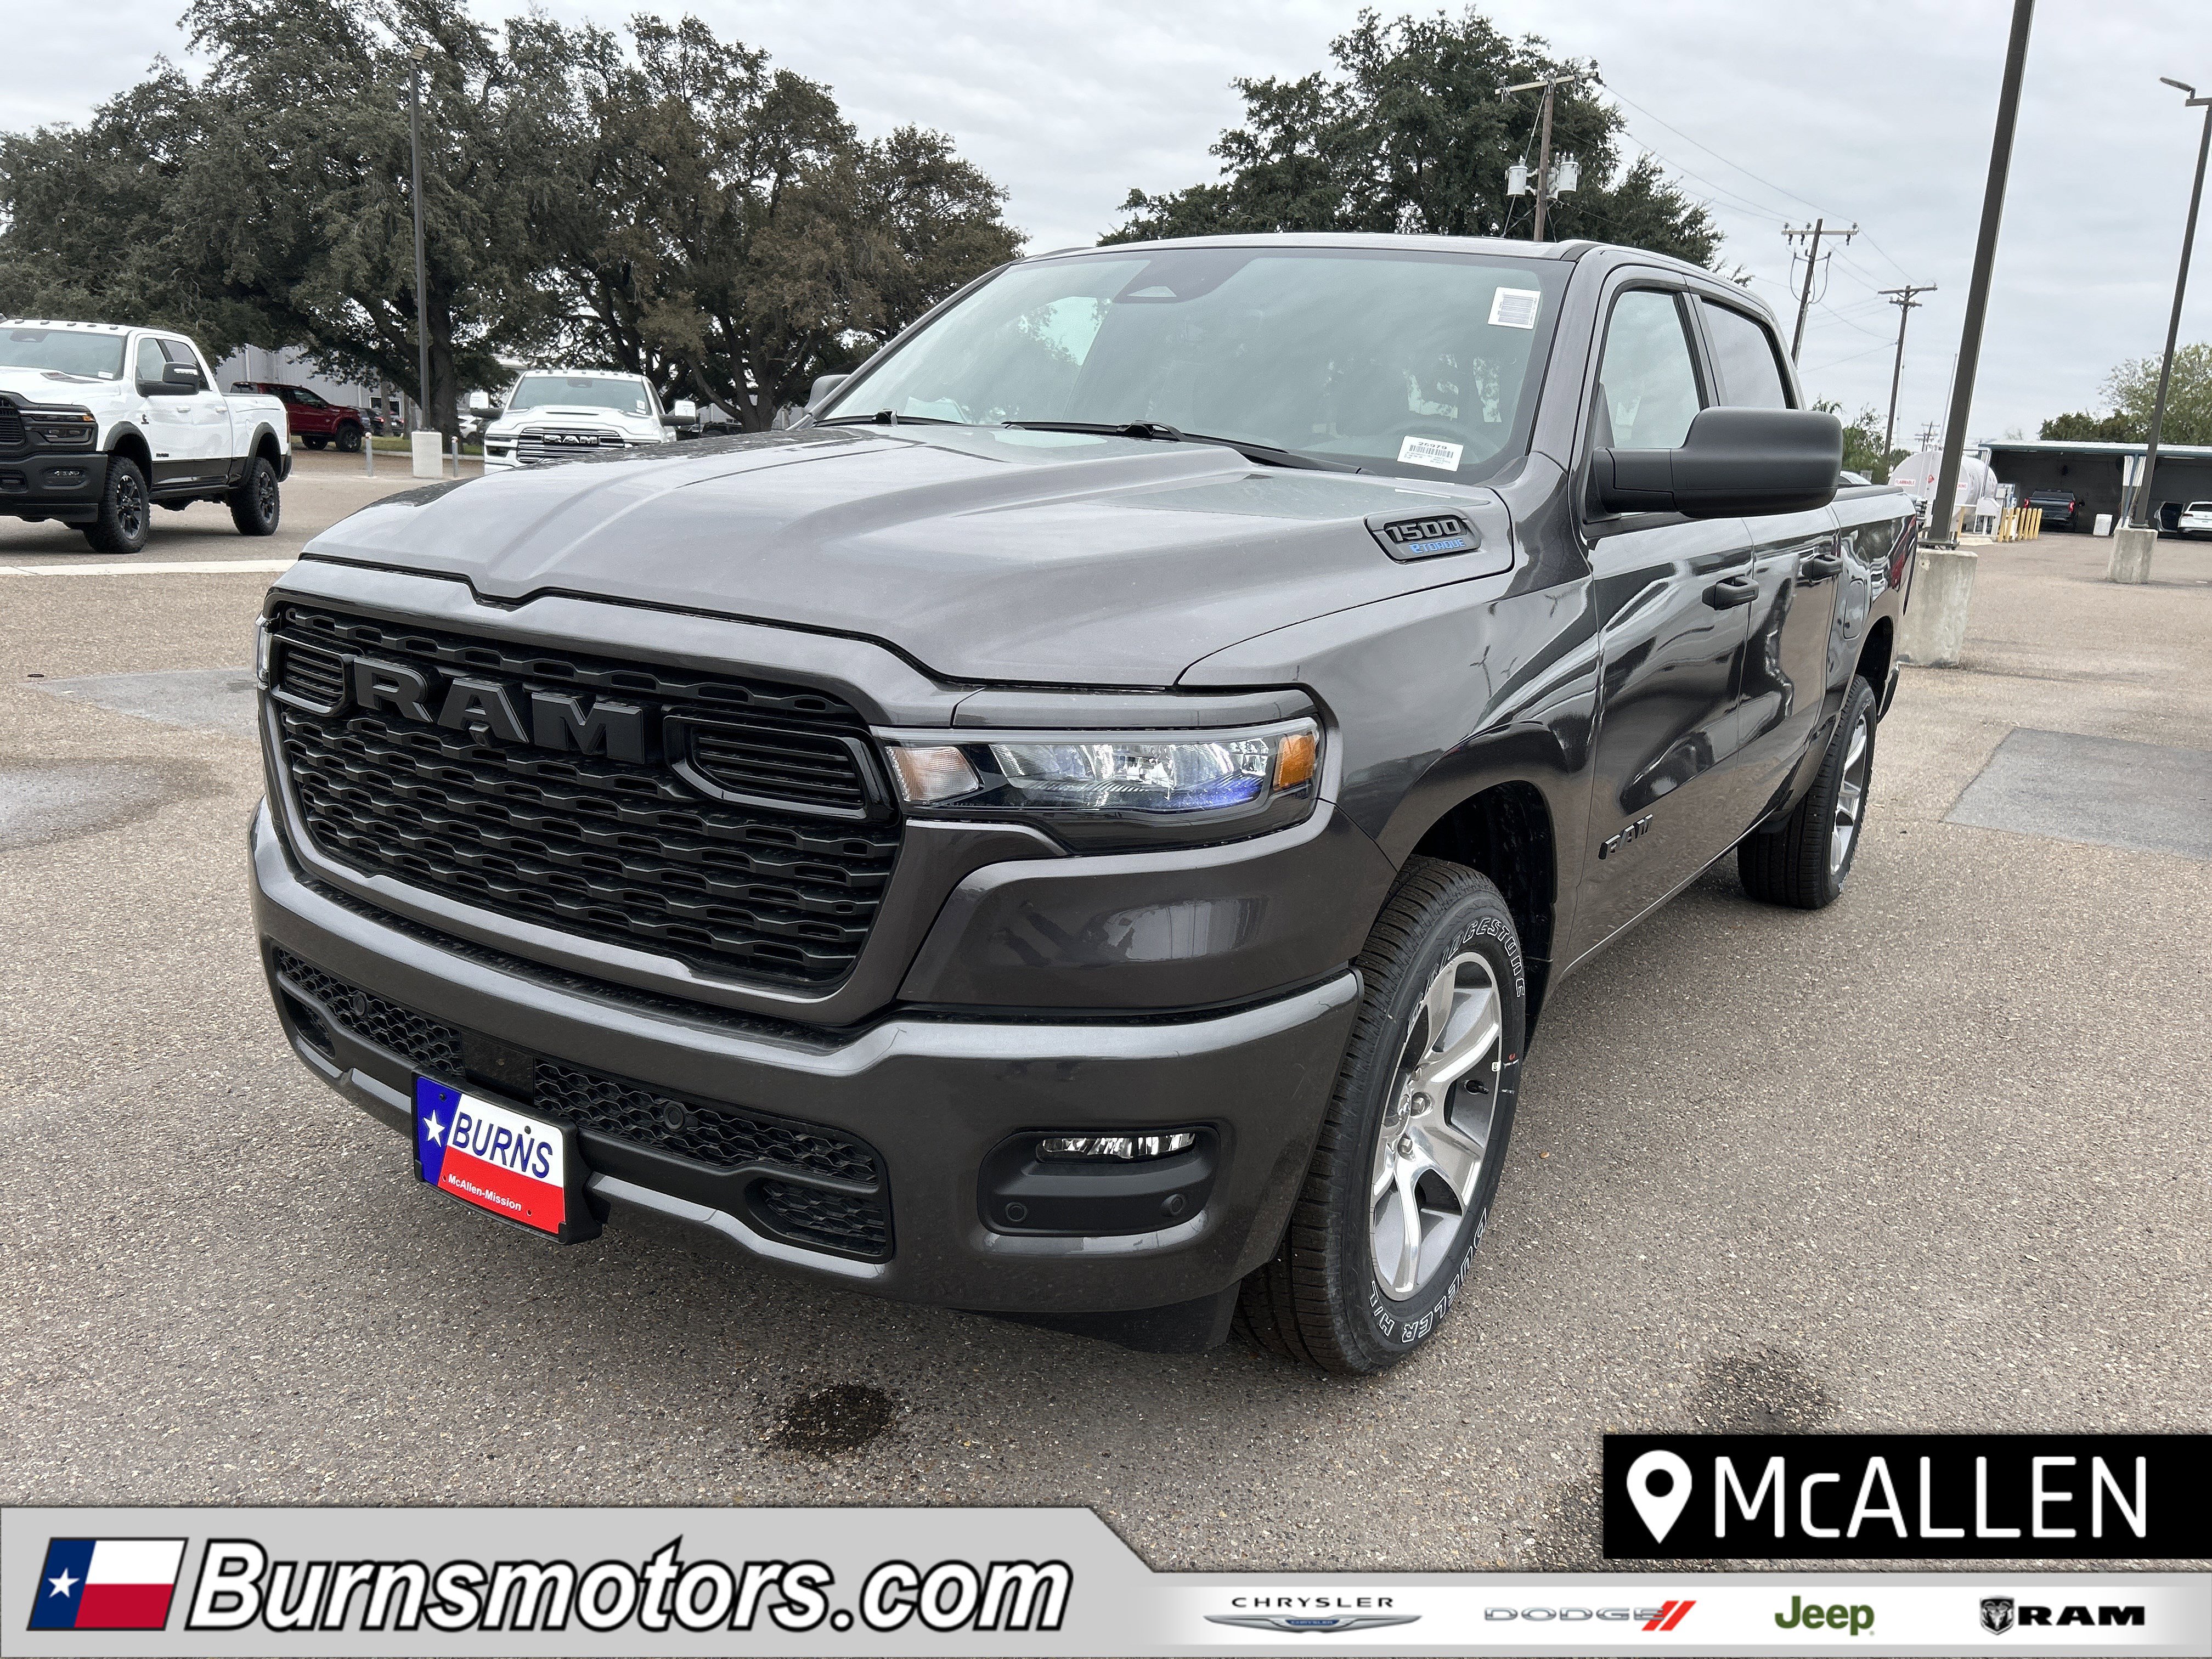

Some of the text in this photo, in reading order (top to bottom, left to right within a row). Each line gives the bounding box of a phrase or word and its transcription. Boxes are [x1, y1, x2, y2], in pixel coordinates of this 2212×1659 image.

[544, 435, 597, 444] RAM
[1386, 519, 1462, 541] 1500
[1409, 538, 1467, 554] eTORQUE
[353, 656, 646, 764] RAM
[1598, 814, 1654, 860] RAM
[452, 1111, 553, 1178] BURNS
[448, 1173, 522, 1212] McAllen-Mission
